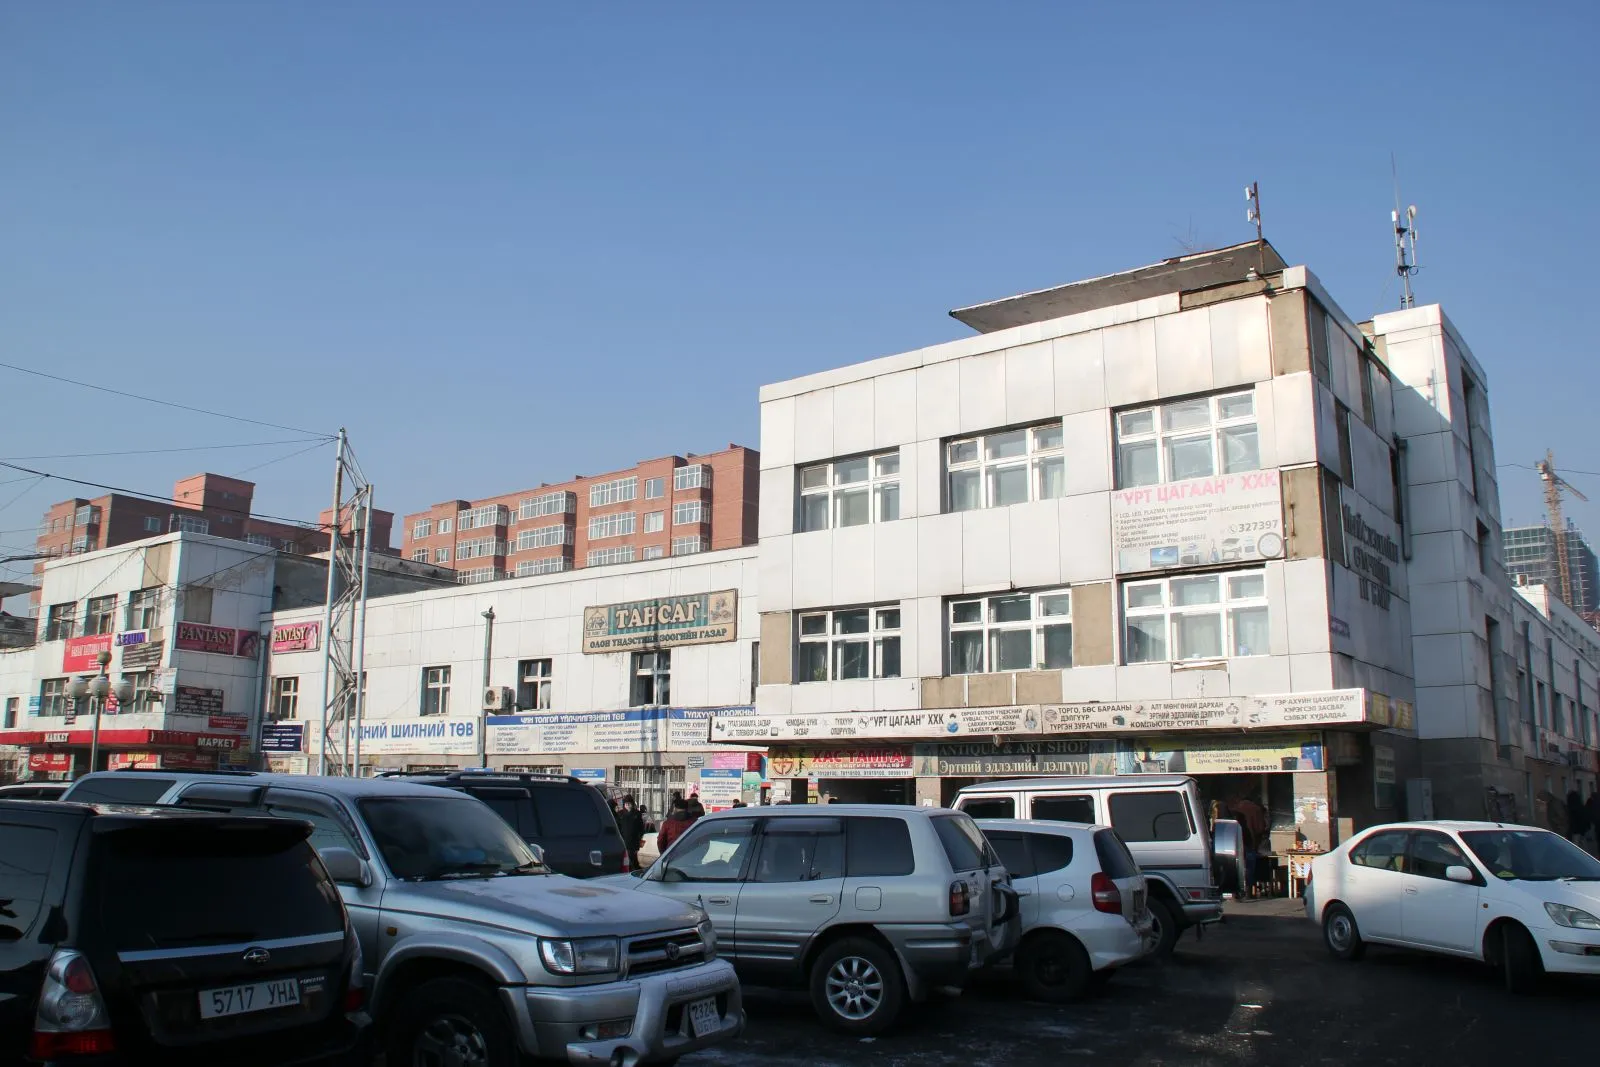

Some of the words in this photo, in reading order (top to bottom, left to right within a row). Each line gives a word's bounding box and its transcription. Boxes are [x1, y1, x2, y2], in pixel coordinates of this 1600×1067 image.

[1241, 472, 1277, 491] ХХК
[1238, 519, 1279, 533] 327397
[616, 601, 700, 629] ТАНСАГ
[181, 625, 233, 642] FANTASY
[275, 627, 307, 641] FANTASY
[590, 640, 610, 648] ОЛОН
[700, 628, 727, 640] ГАЗАР
[1164, 702, 1197, 710] МӨНГӨНИЙ
[1198, 701, 1223, 709] ДАРХАН
[1312, 695, 1354, 703] ЦАХИЛГААН
[1058, 707, 1079, 715] ТОРГО,
[1098, 704, 1132, 712] БАРААНЫ
[1310, 712, 1347, 720] ХУДАЛДАА
[889, 715, 926, 727] ЦАГААН"
[928, 713, 944, 725] ХХК
[1060, 714, 1090, 722] ДЭЛГҮҮР
[391, 720, 445, 738] ШИЛНИЙ
[449, 721, 473, 737] ТӨВ
[1050, 723, 1073, 731] ТҮРГЭН
[1074, 722, 1107, 730] ЗУРАГЧИН
[939, 744, 995, 756] ANTIQUE
[1003, 744, 1012, 754] &
[1017, 743, 1041, 753] ART
[1047, 741, 1088, 753] SHOP
[812, 750, 843, 763] ХАС
[846, 749, 905, 763] ТАМГА
[939, 760, 982, 774] Эртний
[1042, 761, 1088, 775] дэлгүүр
[212, 986, 255, 1014] 5717
